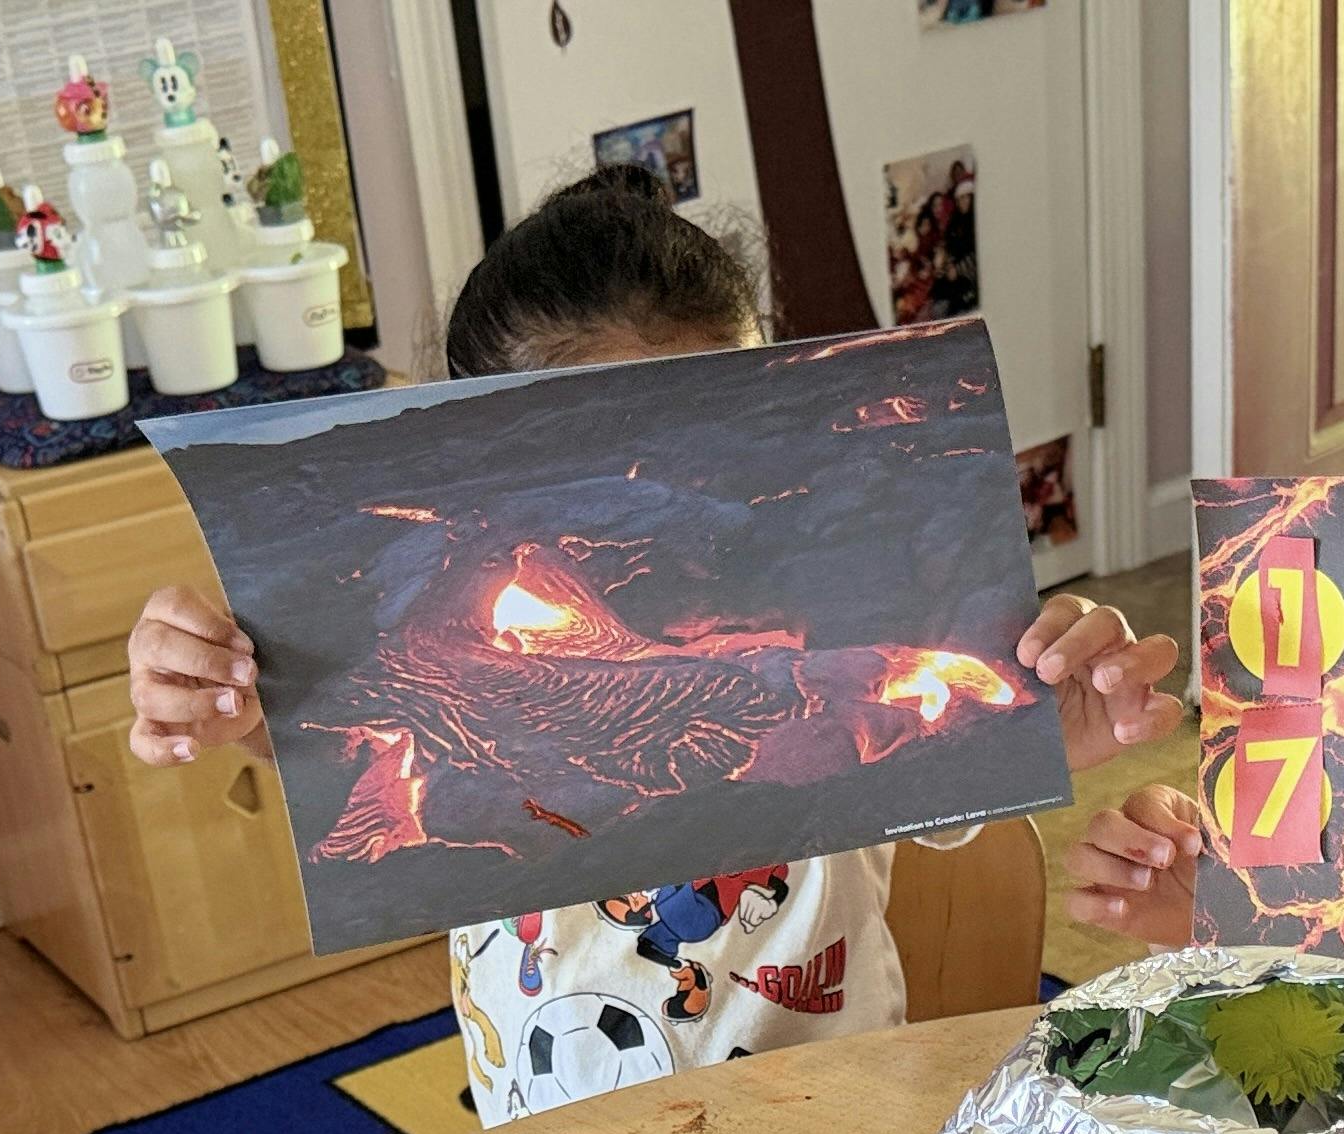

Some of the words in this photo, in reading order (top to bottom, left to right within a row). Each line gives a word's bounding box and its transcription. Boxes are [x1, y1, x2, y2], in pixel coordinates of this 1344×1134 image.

[1268, 567, 1304, 667] 1
[885, 822, 924, 836] Invitation
[925, 820, 935, 828] to
[965, 810, 987, 820] Lava
[1245, 736, 1319, 839] 7
